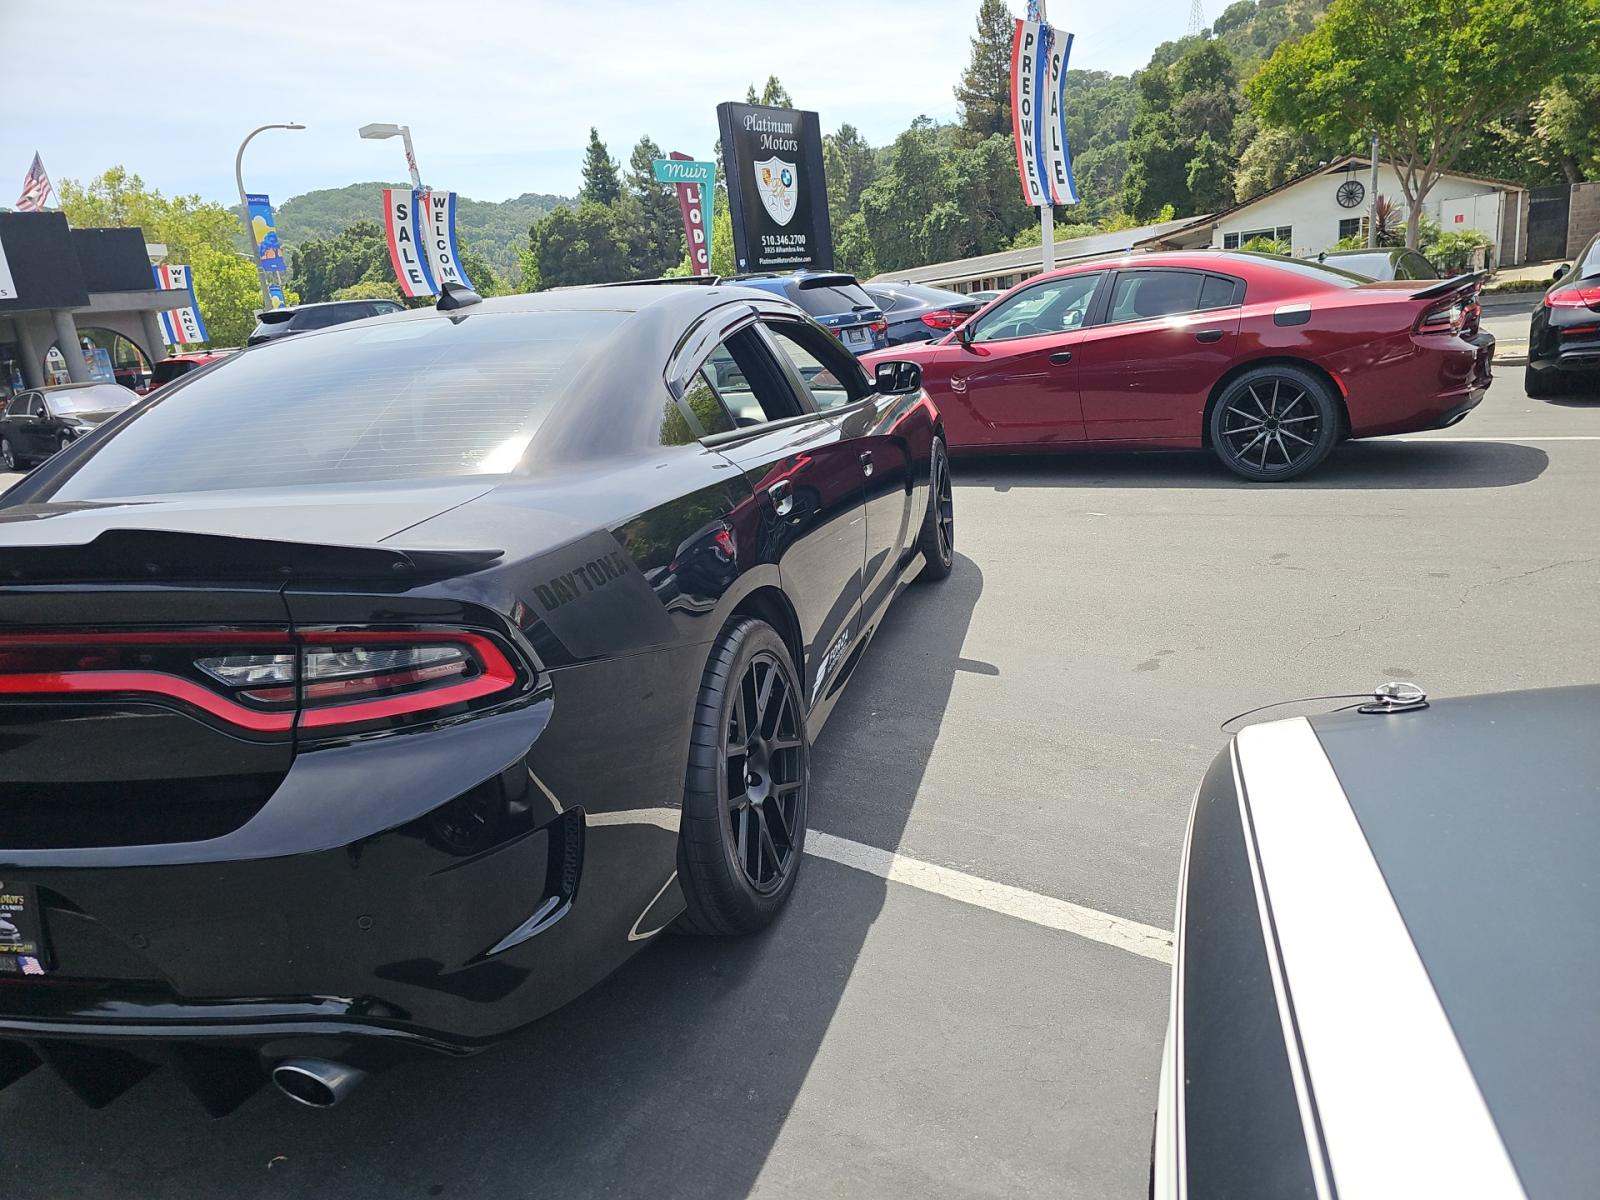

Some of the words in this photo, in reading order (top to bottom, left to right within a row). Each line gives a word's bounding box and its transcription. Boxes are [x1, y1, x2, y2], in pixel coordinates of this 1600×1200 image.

[744, 114, 793, 134] Platinum
[761, 134, 798, 152] Motors
[1021, 33, 1039, 196] PREOWNED
[1051, 54, 1065, 184] SALE
[663, 164, 707, 179] Muir
[396, 204, 422, 284] SALE
[433, 198, 457, 282] WELCOM
[761, 234, 806, 246] 510.346.2700
[532, 551, 629, 611] DAYTONA
